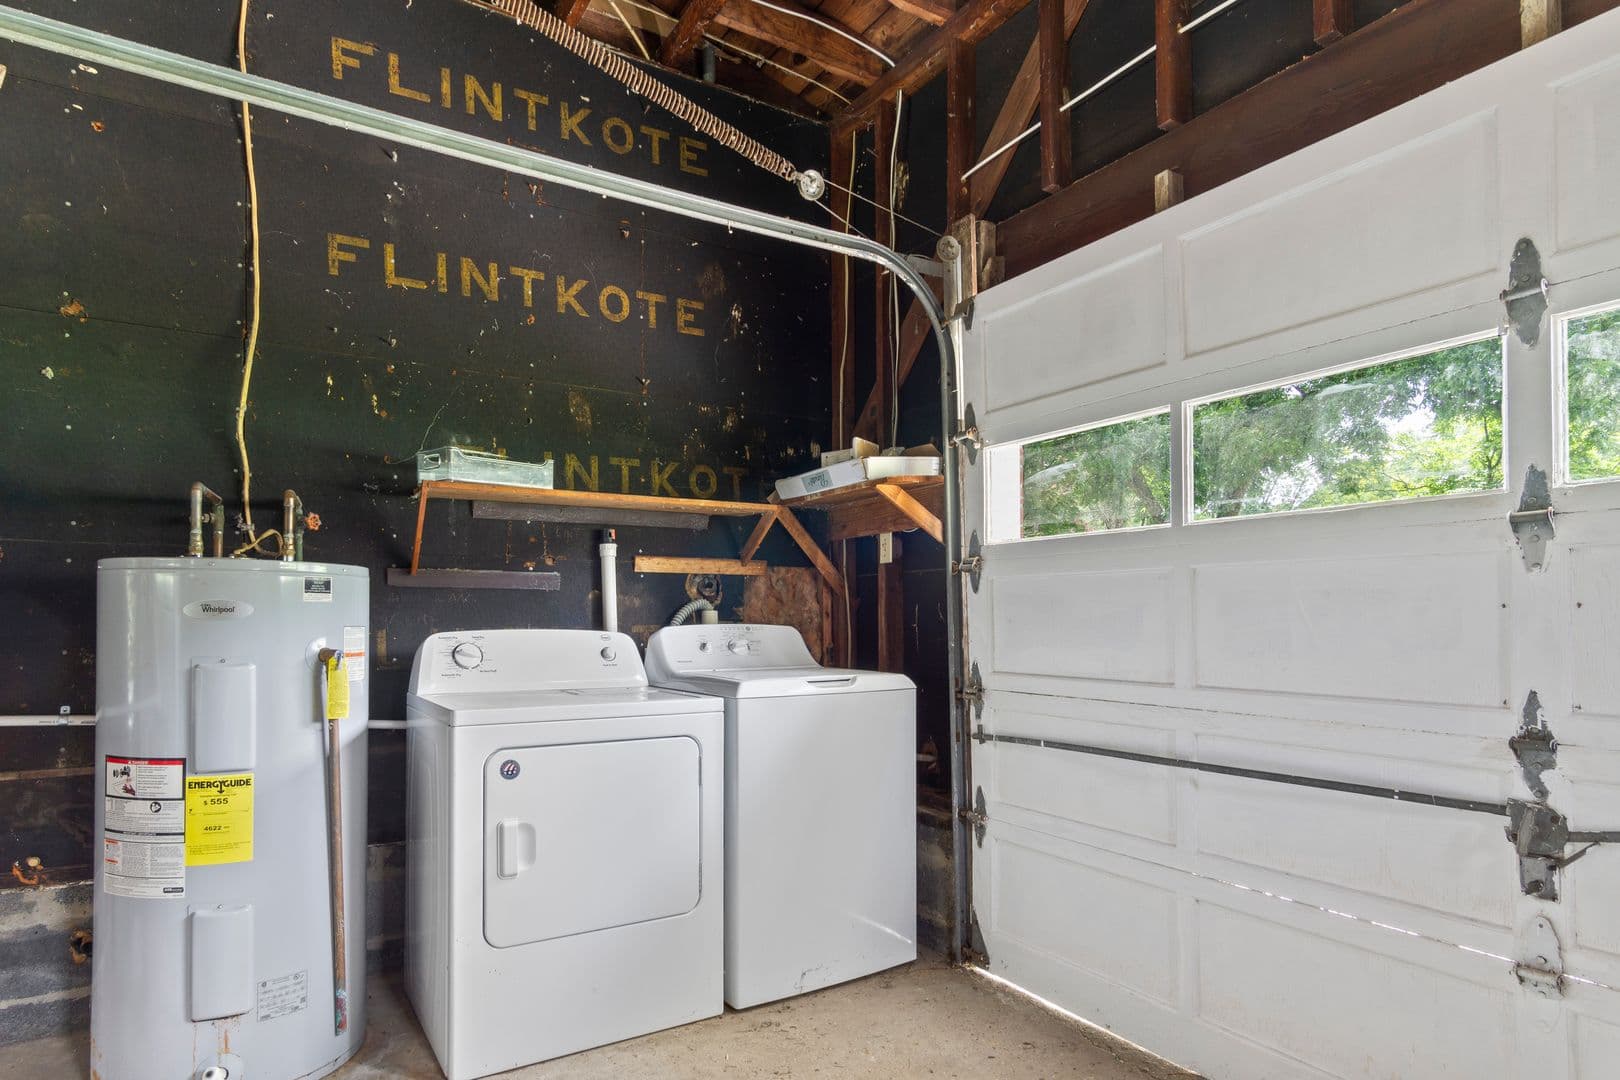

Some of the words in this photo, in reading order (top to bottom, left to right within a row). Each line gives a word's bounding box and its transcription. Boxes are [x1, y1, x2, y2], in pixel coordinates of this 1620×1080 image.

[331, 36, 709, 177] FLINTKOTE
[327, 232, 705, 337] FLINTKOTE
[201, 605, 236, 615] Whirlpool
[188, 778, 252, 793] ENERGYGUIDE
[210, 797, 229, 805] 555
